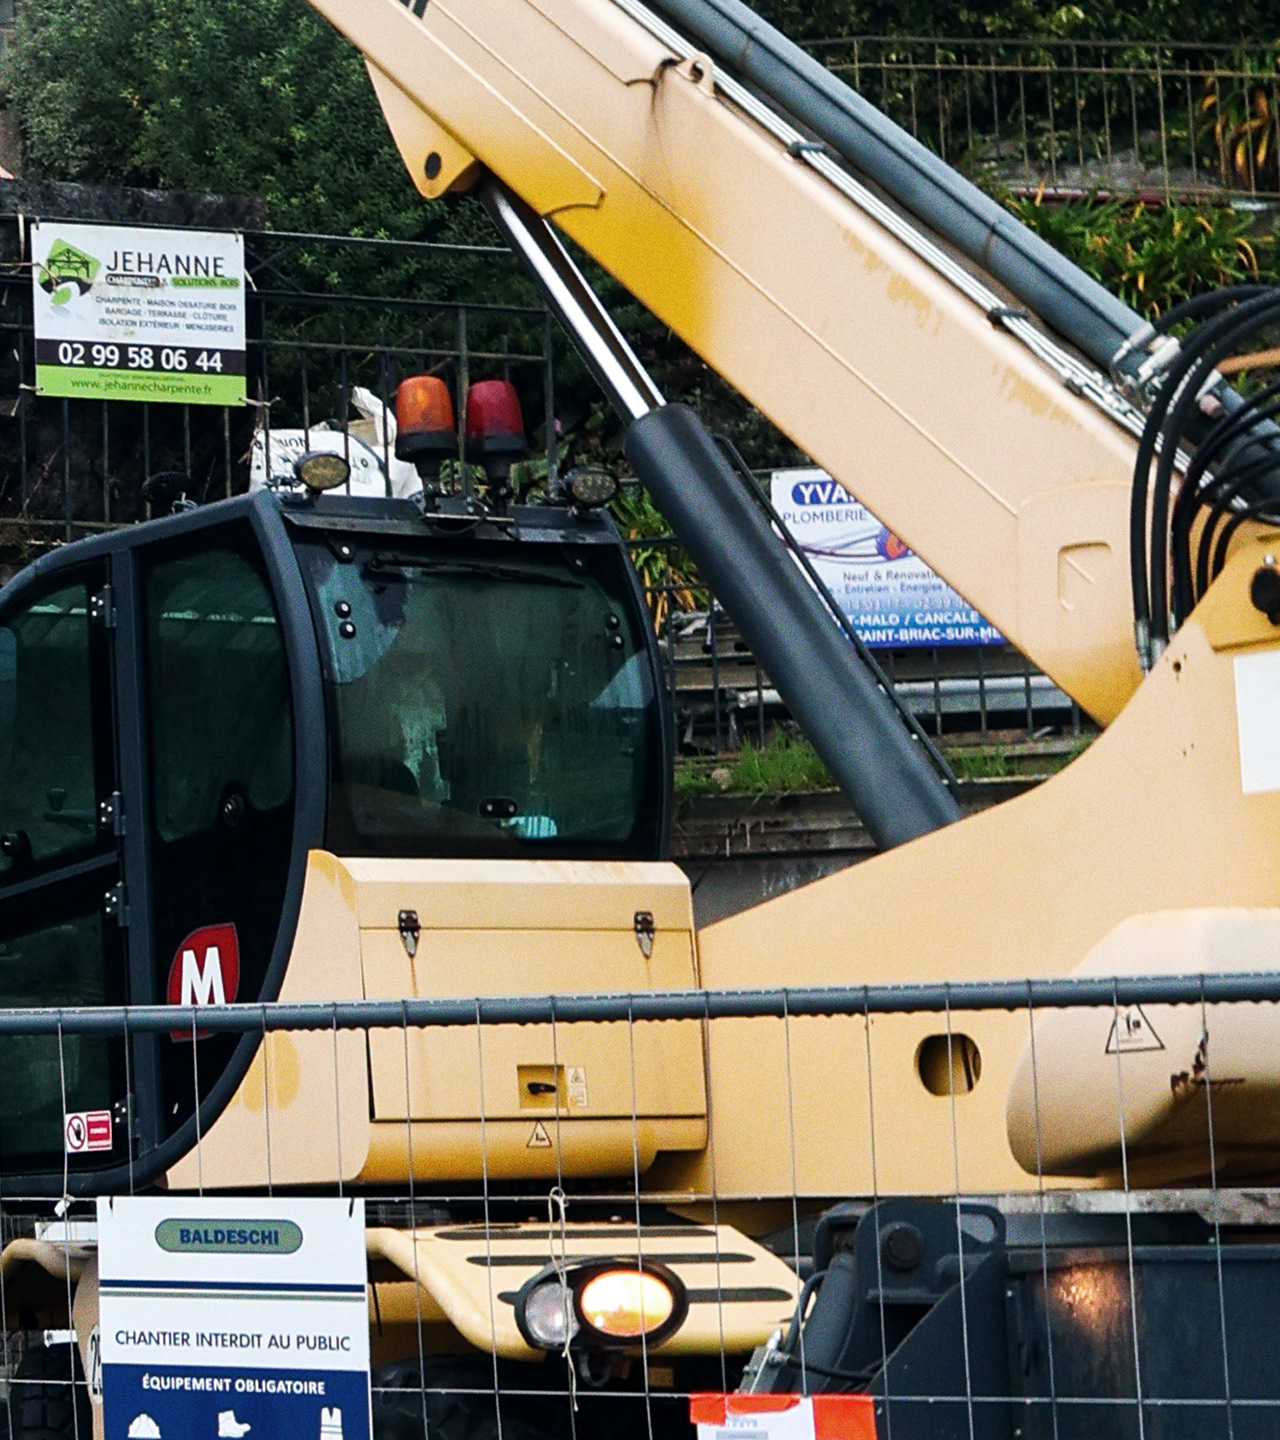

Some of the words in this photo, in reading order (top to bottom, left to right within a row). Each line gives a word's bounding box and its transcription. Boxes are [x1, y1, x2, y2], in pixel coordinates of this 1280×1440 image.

[106, 250, 226, 278] JEHANNE
[95, 296, 141, 306] CHARPENTE
[146, 298, 176, 308] MAISON
[178, 300, 217, 310] OSSATURE
[219, 303, 237, 311] BOIS
[98, 318, 137, 327] ISOLATION
[147, 309, 187, 319] TERRASSE
[58, 342, 85, 365] 02
[91, 344, 120, 367] 99
[127, 346, 154, 369] 58
[161, 348, 188, 371] 06
[195, 350, 223, 372] 44
[798, 483, 855, 504] YVA
[782, 508, 868, 524] PLOMBERIE
[843, 570, 869, 582] Neuf
[873, 571, 882, 581] &
[845, 583, 890, 595] Entretien
[914, 611, 980, 624] CANCALE
[180, 946, 226, 1006] M
[180, 1228, 279, 1246] BALDESCHI
[115, 1330, 190, 1347] CHANTIER
[196, 1332, 263, 1349] INTERDIT
[267, 1334, 290, 1350] AU
[296, 1335, 351, 1351] PUBLIC
[142, 1373, 232, 1392] ÉQUIPEMENT
[235, 1378, 326, 1395] OBLIGATOIRE
